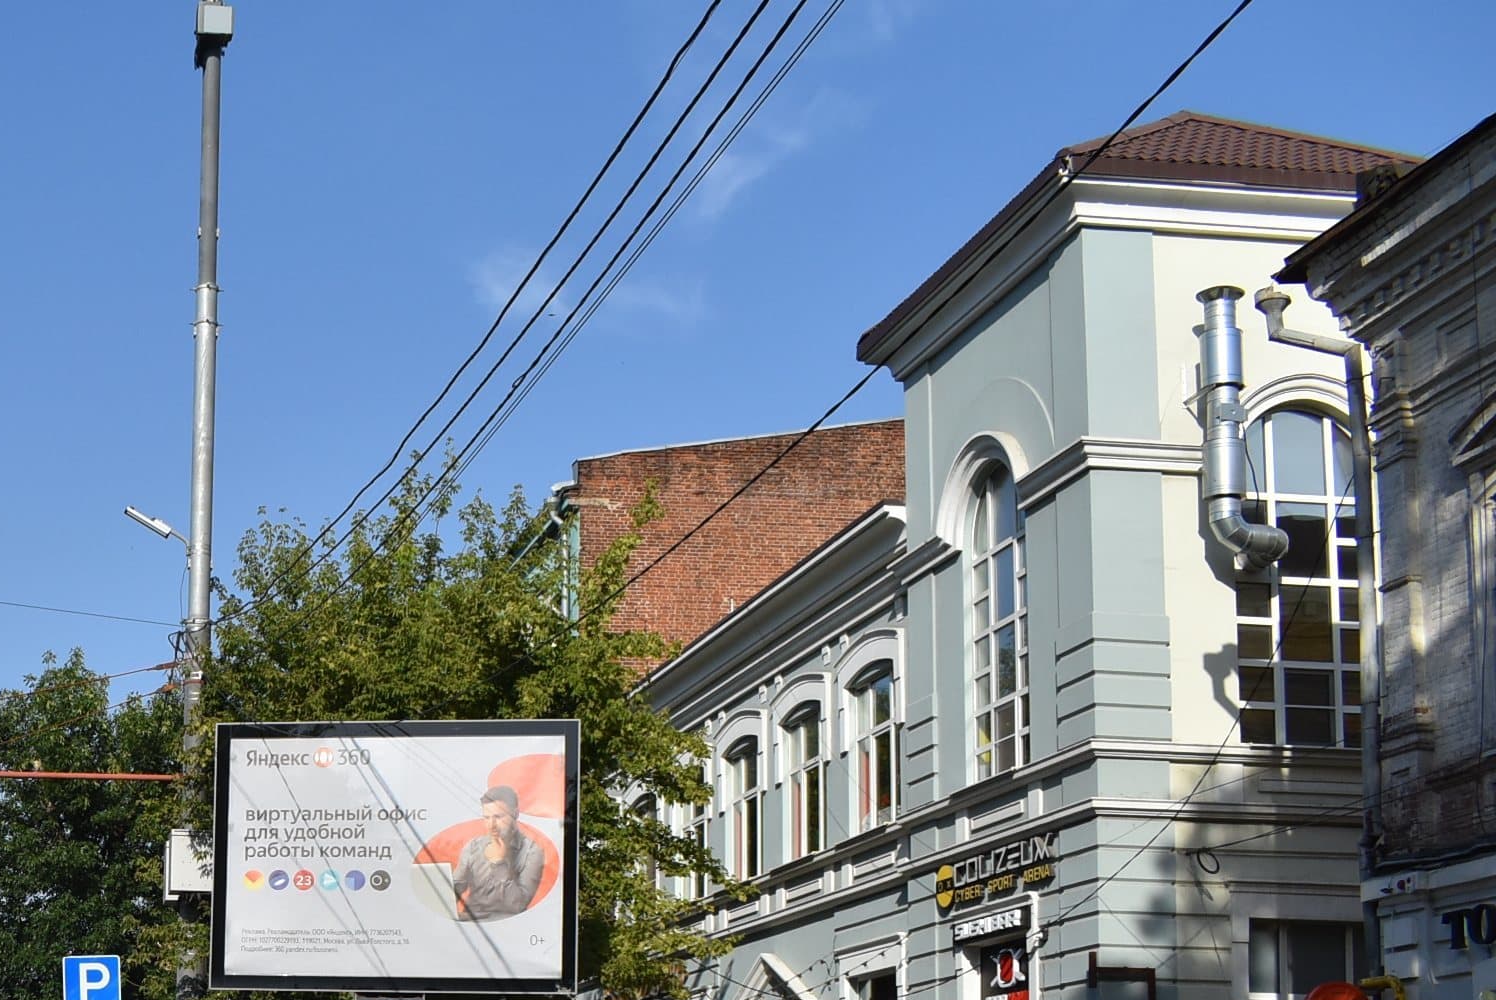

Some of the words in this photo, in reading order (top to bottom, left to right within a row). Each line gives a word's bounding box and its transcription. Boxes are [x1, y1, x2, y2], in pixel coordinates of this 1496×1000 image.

[246, 750, 310, 768] Яндекс
[338, 749, 371, 766] 360
[246, 805, 372, 824] виртуальный
[377, 806, 427, 824] офис
[244, 827, 279, 842] для
[284, 824, 365, 842] удобной
[245, 843, 314, 861] работы
[320, 846, 392, 860] команд
[296, 875, 312, 885] 23
[955, 884, 981, 902] CYBER
[987, 874, 1014, 893] SPORT
[1022, 864, 1051, 883] ARENA
[529, 934, 544, 945] 0+
